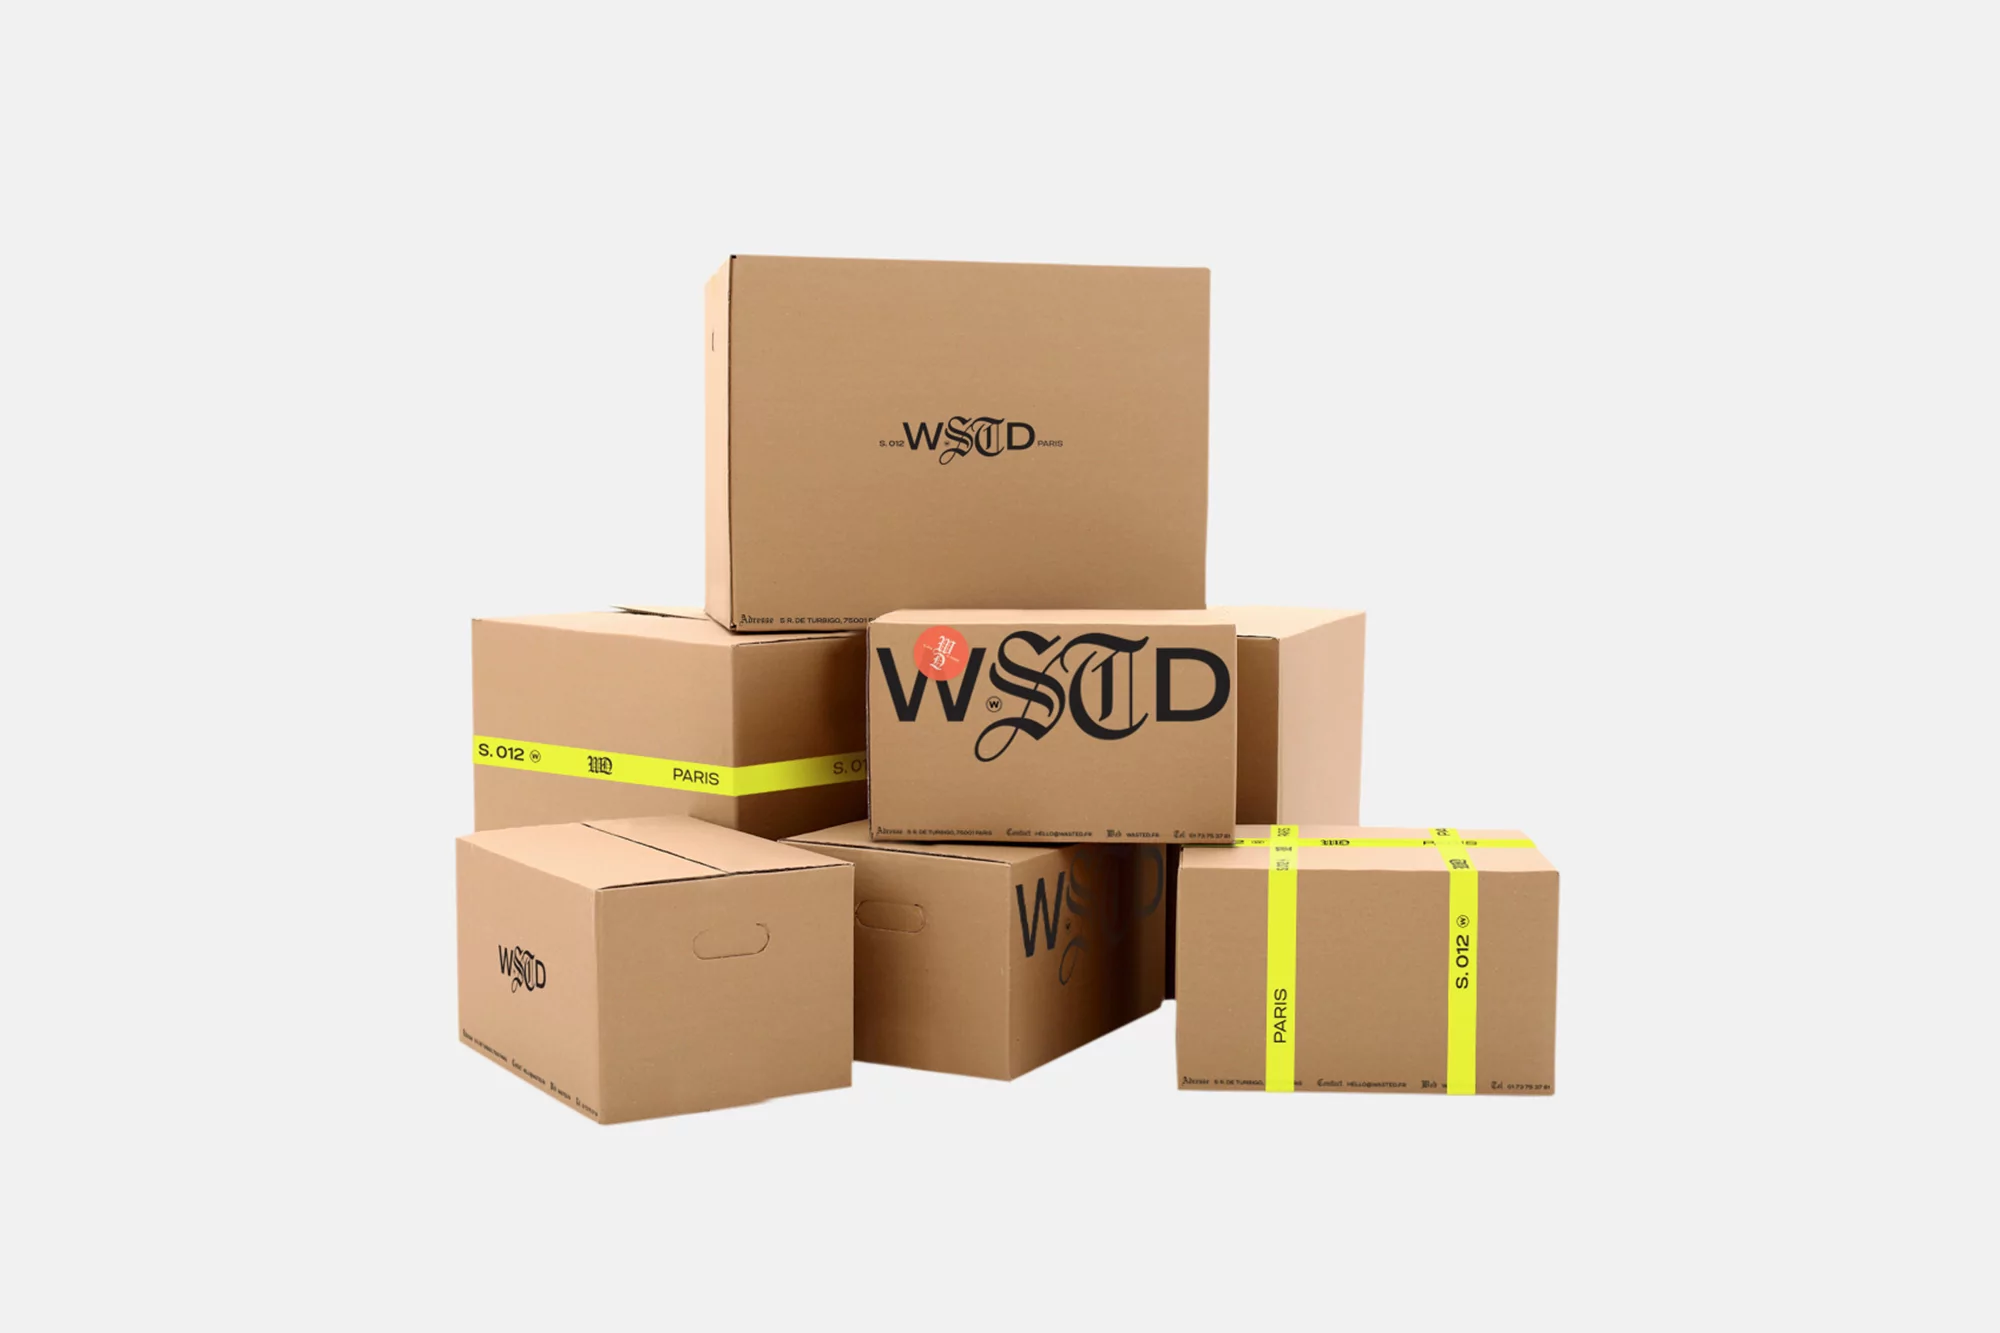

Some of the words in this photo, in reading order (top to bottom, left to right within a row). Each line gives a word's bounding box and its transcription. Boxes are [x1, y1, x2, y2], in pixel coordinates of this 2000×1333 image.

[740, 614, 774, 625] Adresse
[496, 745, 525, 761] 012
[673, 768, 720, 786] PARIS
[1455, 934, 1470, 968] 012
[1273, 988, 1287, 1044] PARIS
